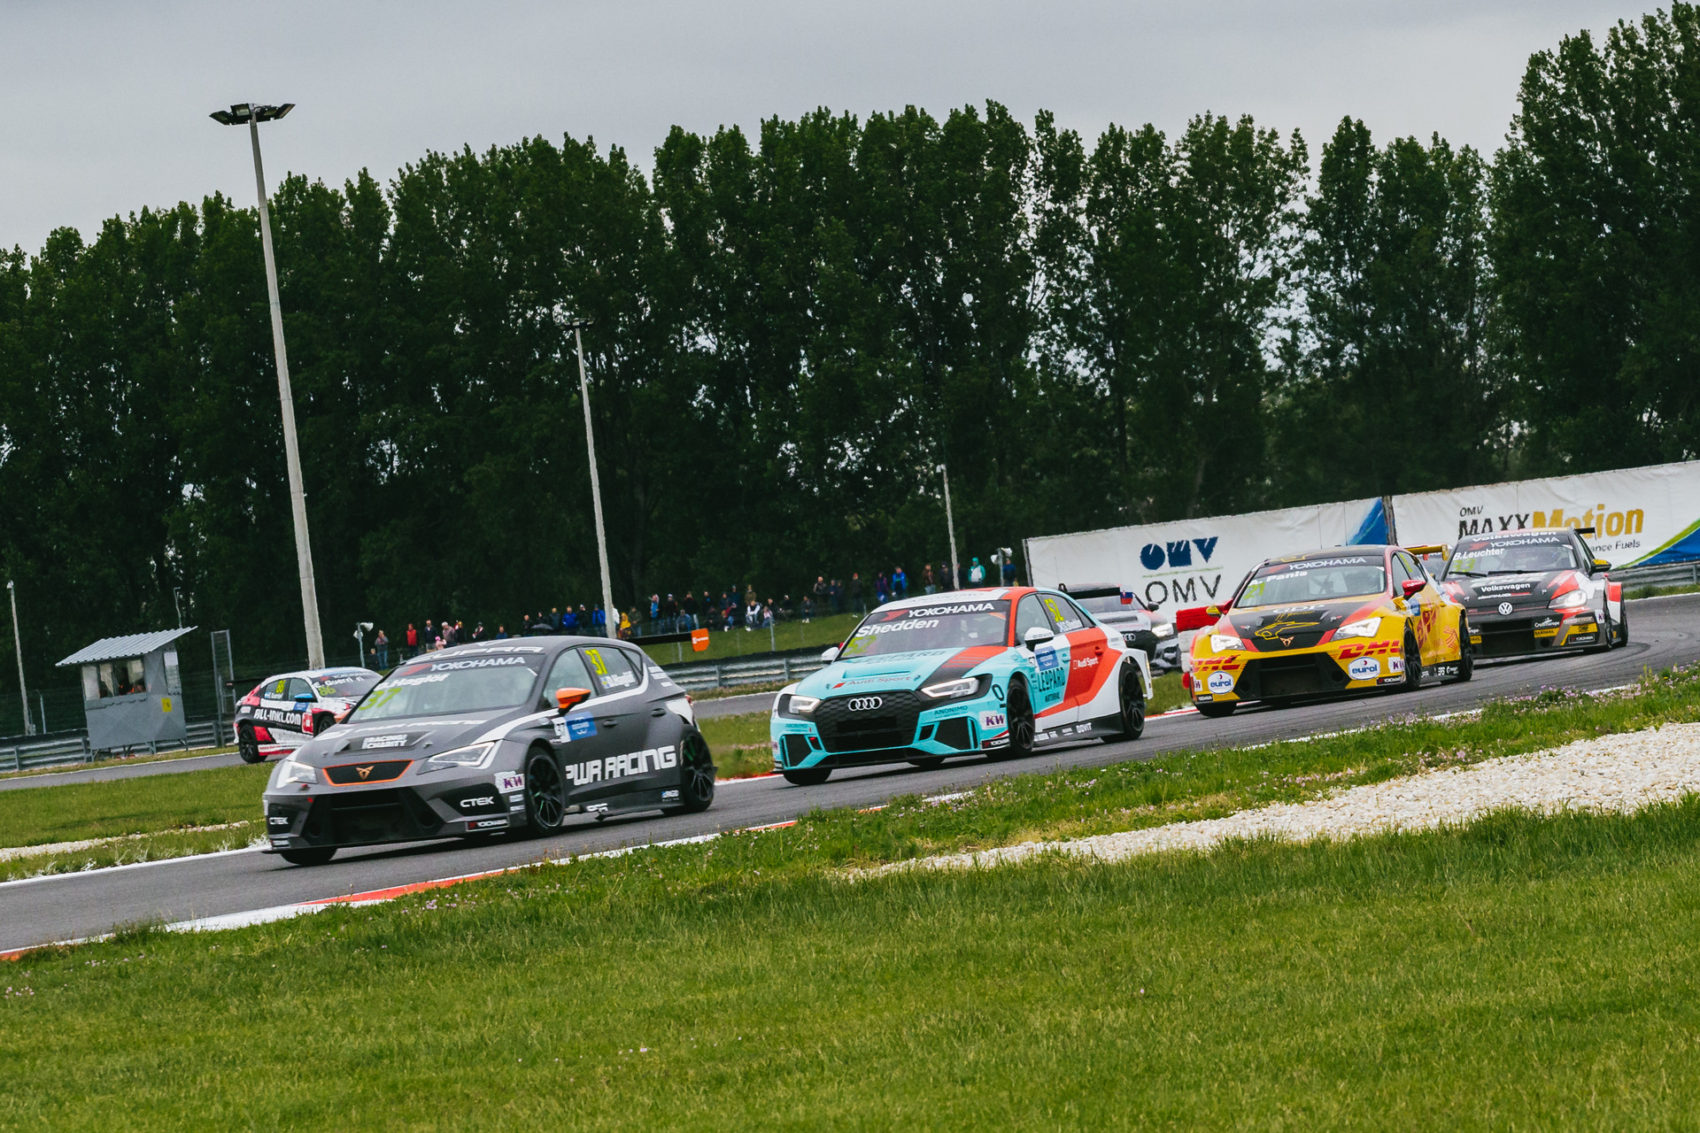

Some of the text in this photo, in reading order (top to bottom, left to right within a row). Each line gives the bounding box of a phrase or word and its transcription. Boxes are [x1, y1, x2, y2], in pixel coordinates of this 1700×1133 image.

[1460, 505, 1484, 517] OMV
[1490, 536, 1560, 548] YOKOHAMA
[1615, 539, 1641, 550] Fuels
[1140, 536, 1219, 571] OMV
[1289, 556, 1367, 570] YOKOHAMA
[1145, 574, 1222, 604] OMV
[1244, 581, 1266, 600] 21
[1481, 583, 1531, 593] Volkswagen
[908, 602, 995, 618] YOKOHAMA
[856, 619, 940, 638] Shedden
[1338, 640, 1402, 660] DHL
[430, 656, 526, 671] YOKOHAMA
[584, 648, 608, 675] 37
[1352, 664, 1378, 674] eurol
[1210, 679, 1232, 688] eurol
[318, 686, 336, 697] 86
[359, 687, 402, 711] 37
[985, 715, 1004, 726] KW
[605, 745, 677, 780] RACING
[503, 775, 523, 789] KW
[460, 796, 494, 808] CTEK
[269, 816, 289, 825] CTEK
